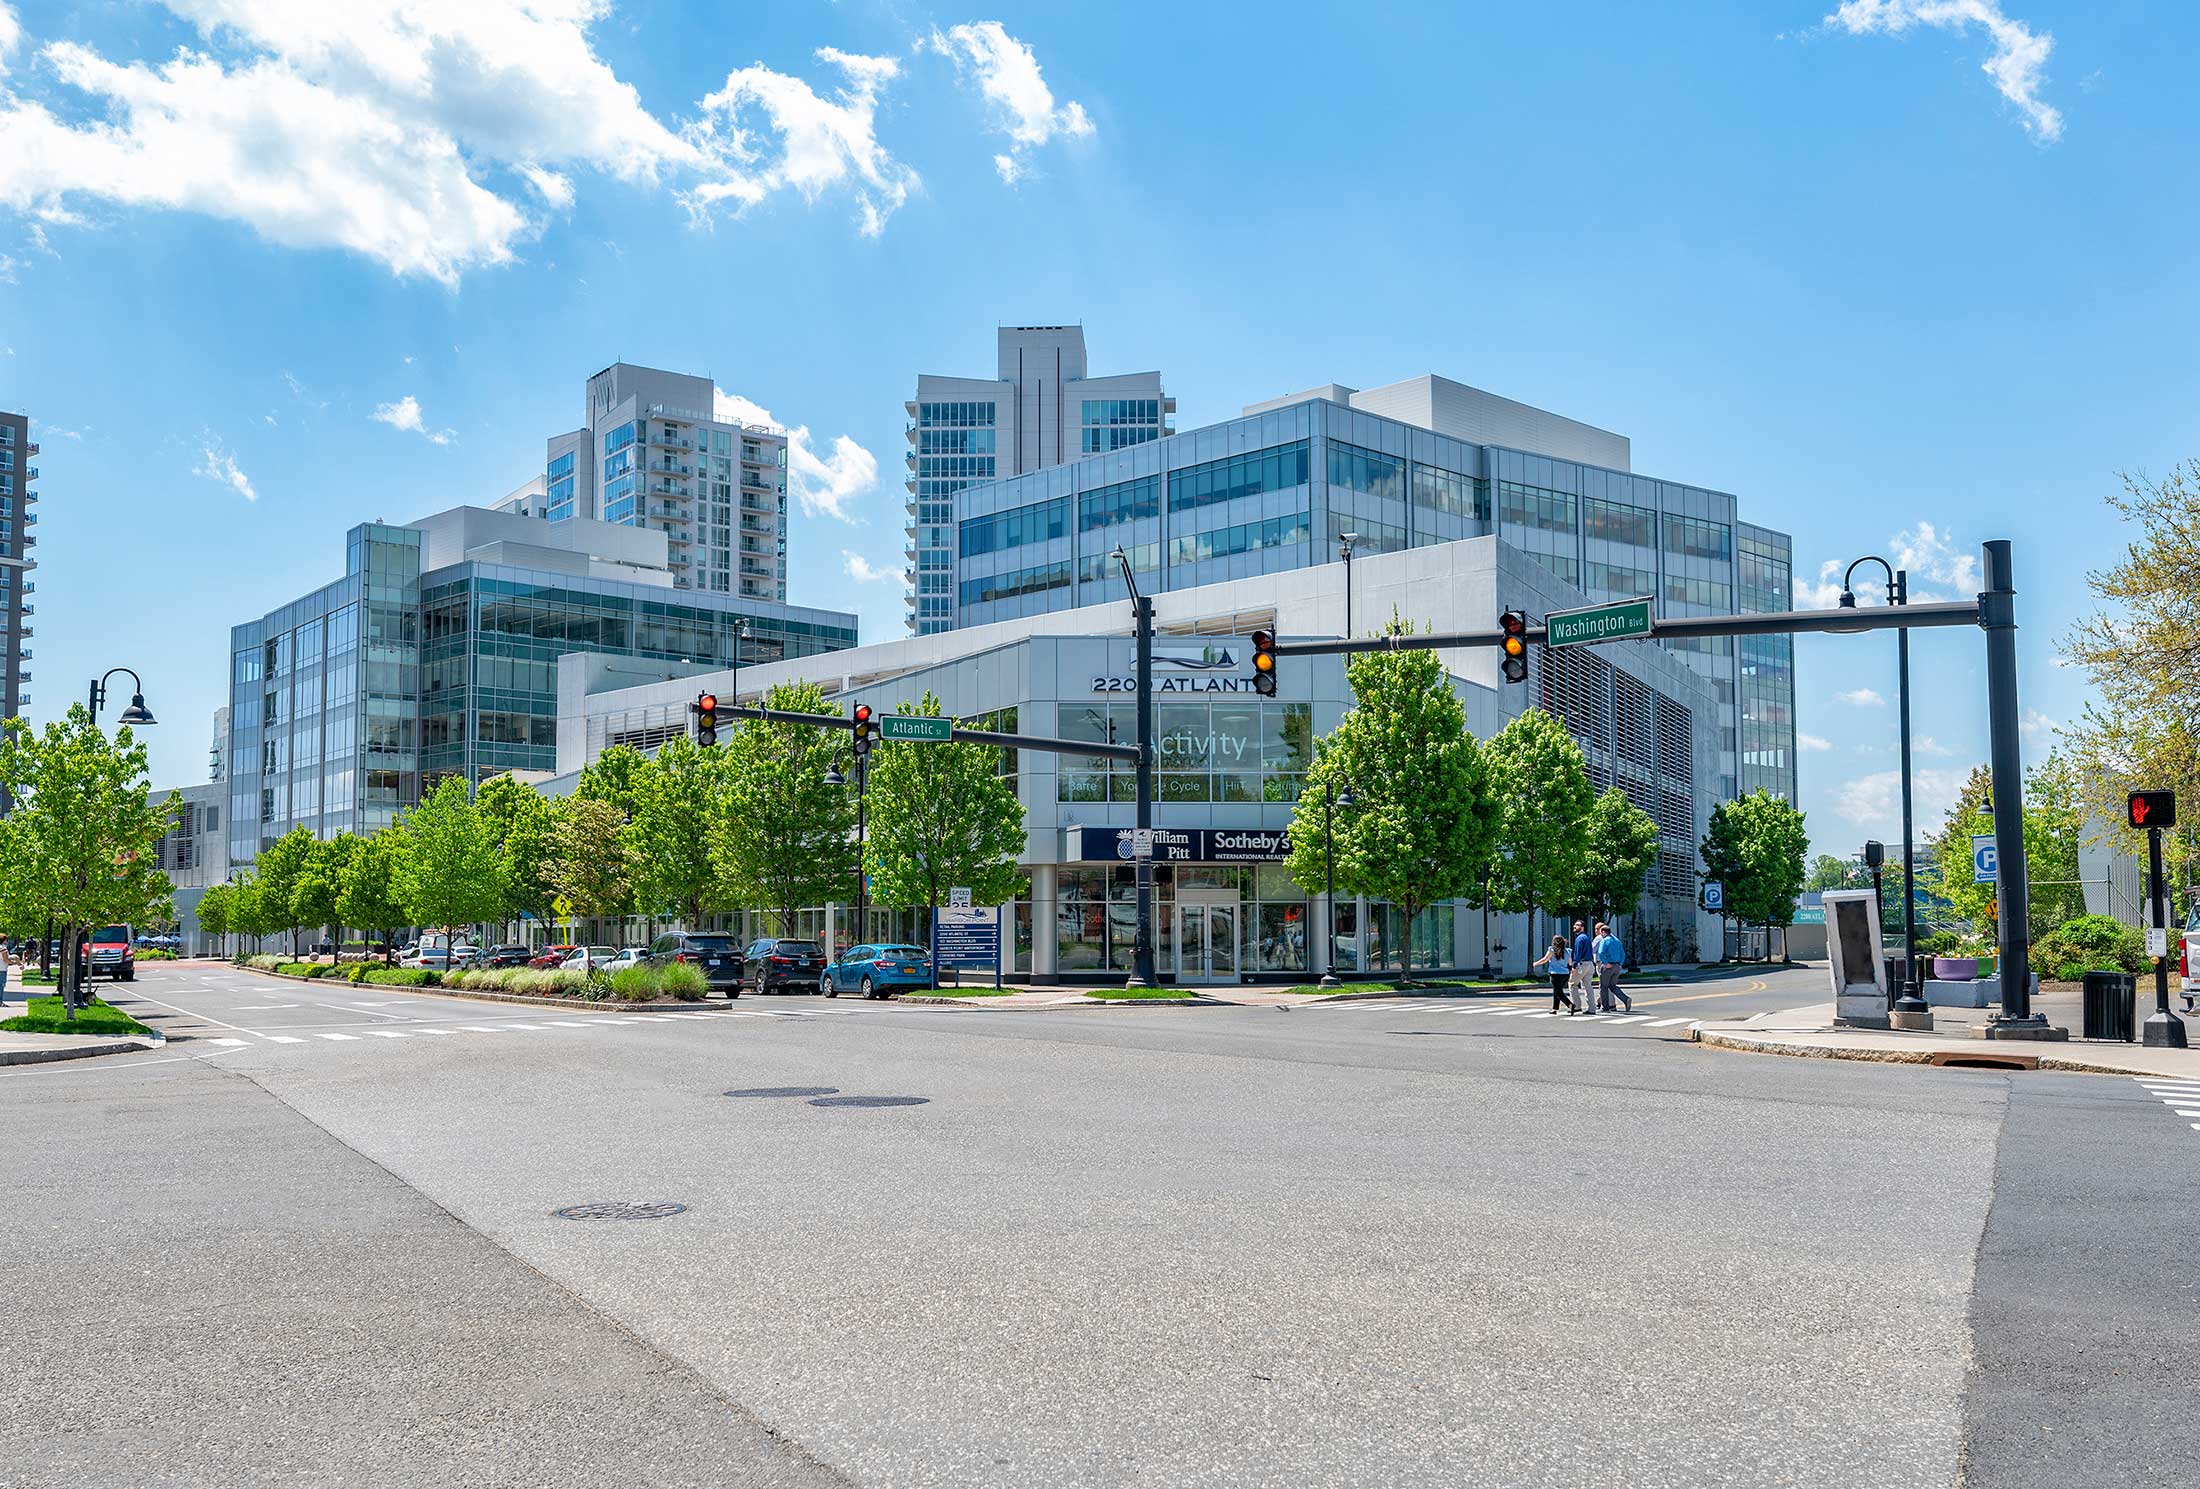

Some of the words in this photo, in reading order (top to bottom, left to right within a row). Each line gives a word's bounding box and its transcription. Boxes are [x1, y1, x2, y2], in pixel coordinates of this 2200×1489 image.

[1555, 616, 1625, 639] Washington
[1629, 618, 1644, 628] Blvd
[1094, 678, 1152, 691] 220
[1161, 678, 1252, 691] ATLANT
[892, 722, 933, 735] Atlantic
[1170, 780, 1200, 794] Cycle
[1215, 831, 1290, 853] Sotheby's
[1167, 846, 1190, 859] Pitt
[1983, 850, 1997, 868] P
[1710, 891, 1718, 901] P
